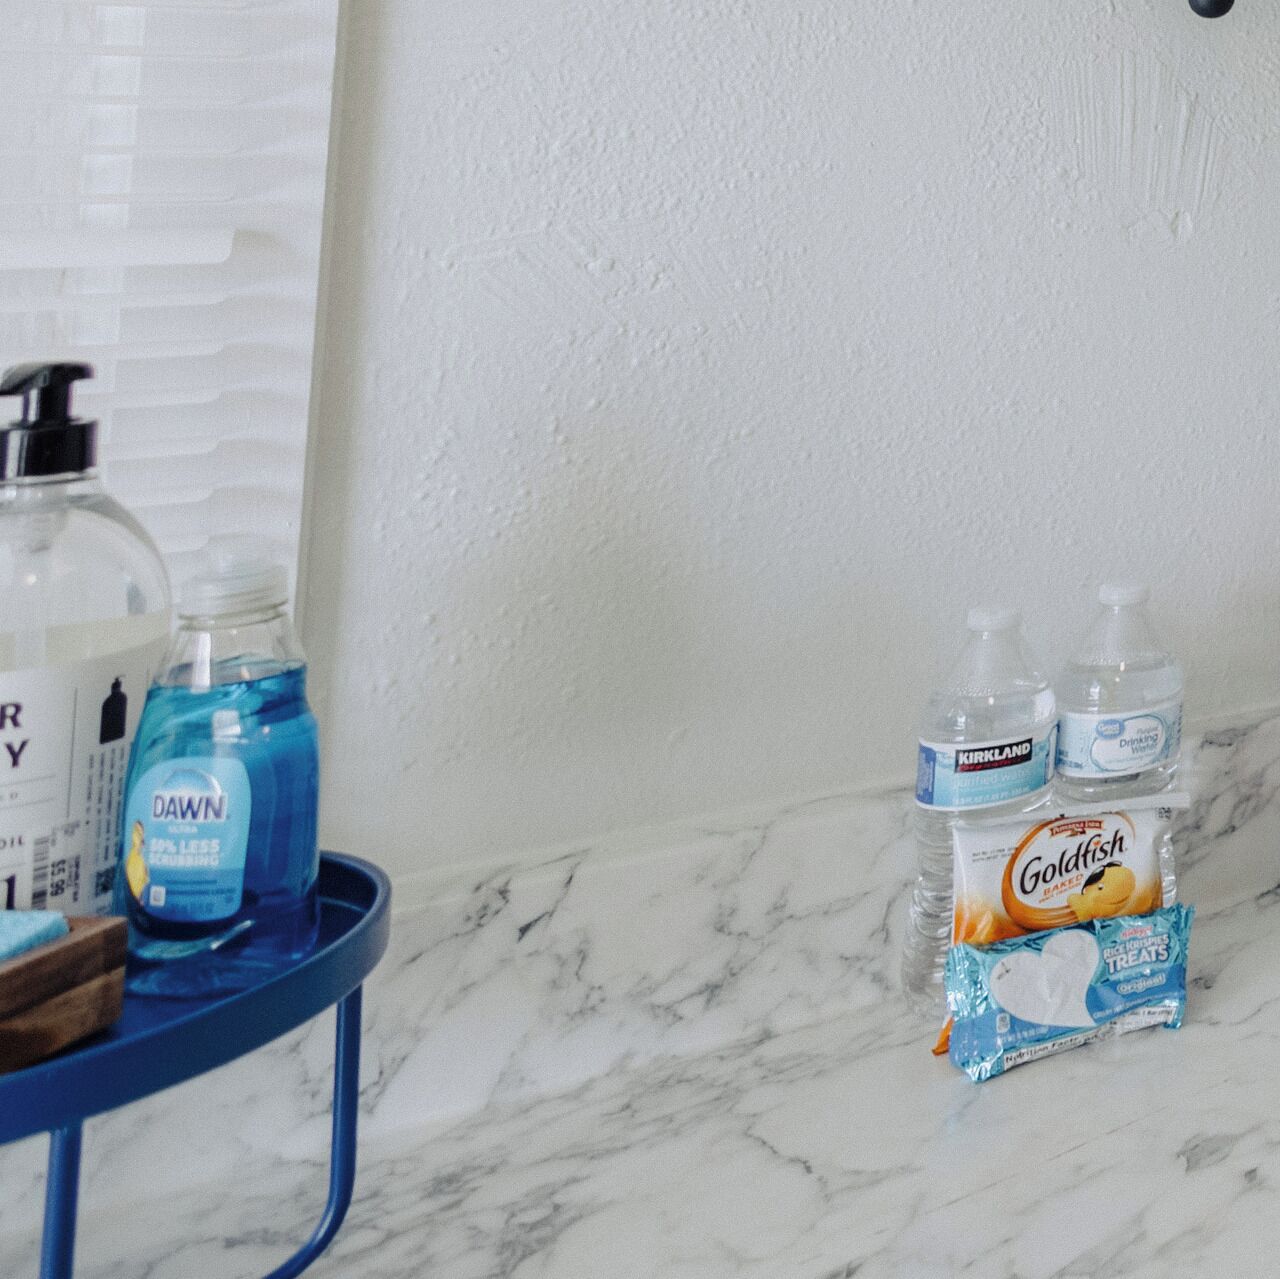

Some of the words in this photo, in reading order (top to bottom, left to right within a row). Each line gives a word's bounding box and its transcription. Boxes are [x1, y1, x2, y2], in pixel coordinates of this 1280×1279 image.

[1119, 733, 1159, 748] Drinking
[959, 743, 1031, 764] KIRKLAND
[153, 794, 226, 821] DAWN
[178, 838, 220, 854] LESS
[1020, 829, 1124, 896] Goldfish
[1043, 874, 1084, 897] BAKED
[1103, 944, 1126, 960] RICE
[1126, 933, 1169, 951] KRISPIES
[1105, 945, 1169, 975] TREATS
[1118, 973, 1165, 993] Original
[1005, 1044, 1049, 1064] Nutrition
